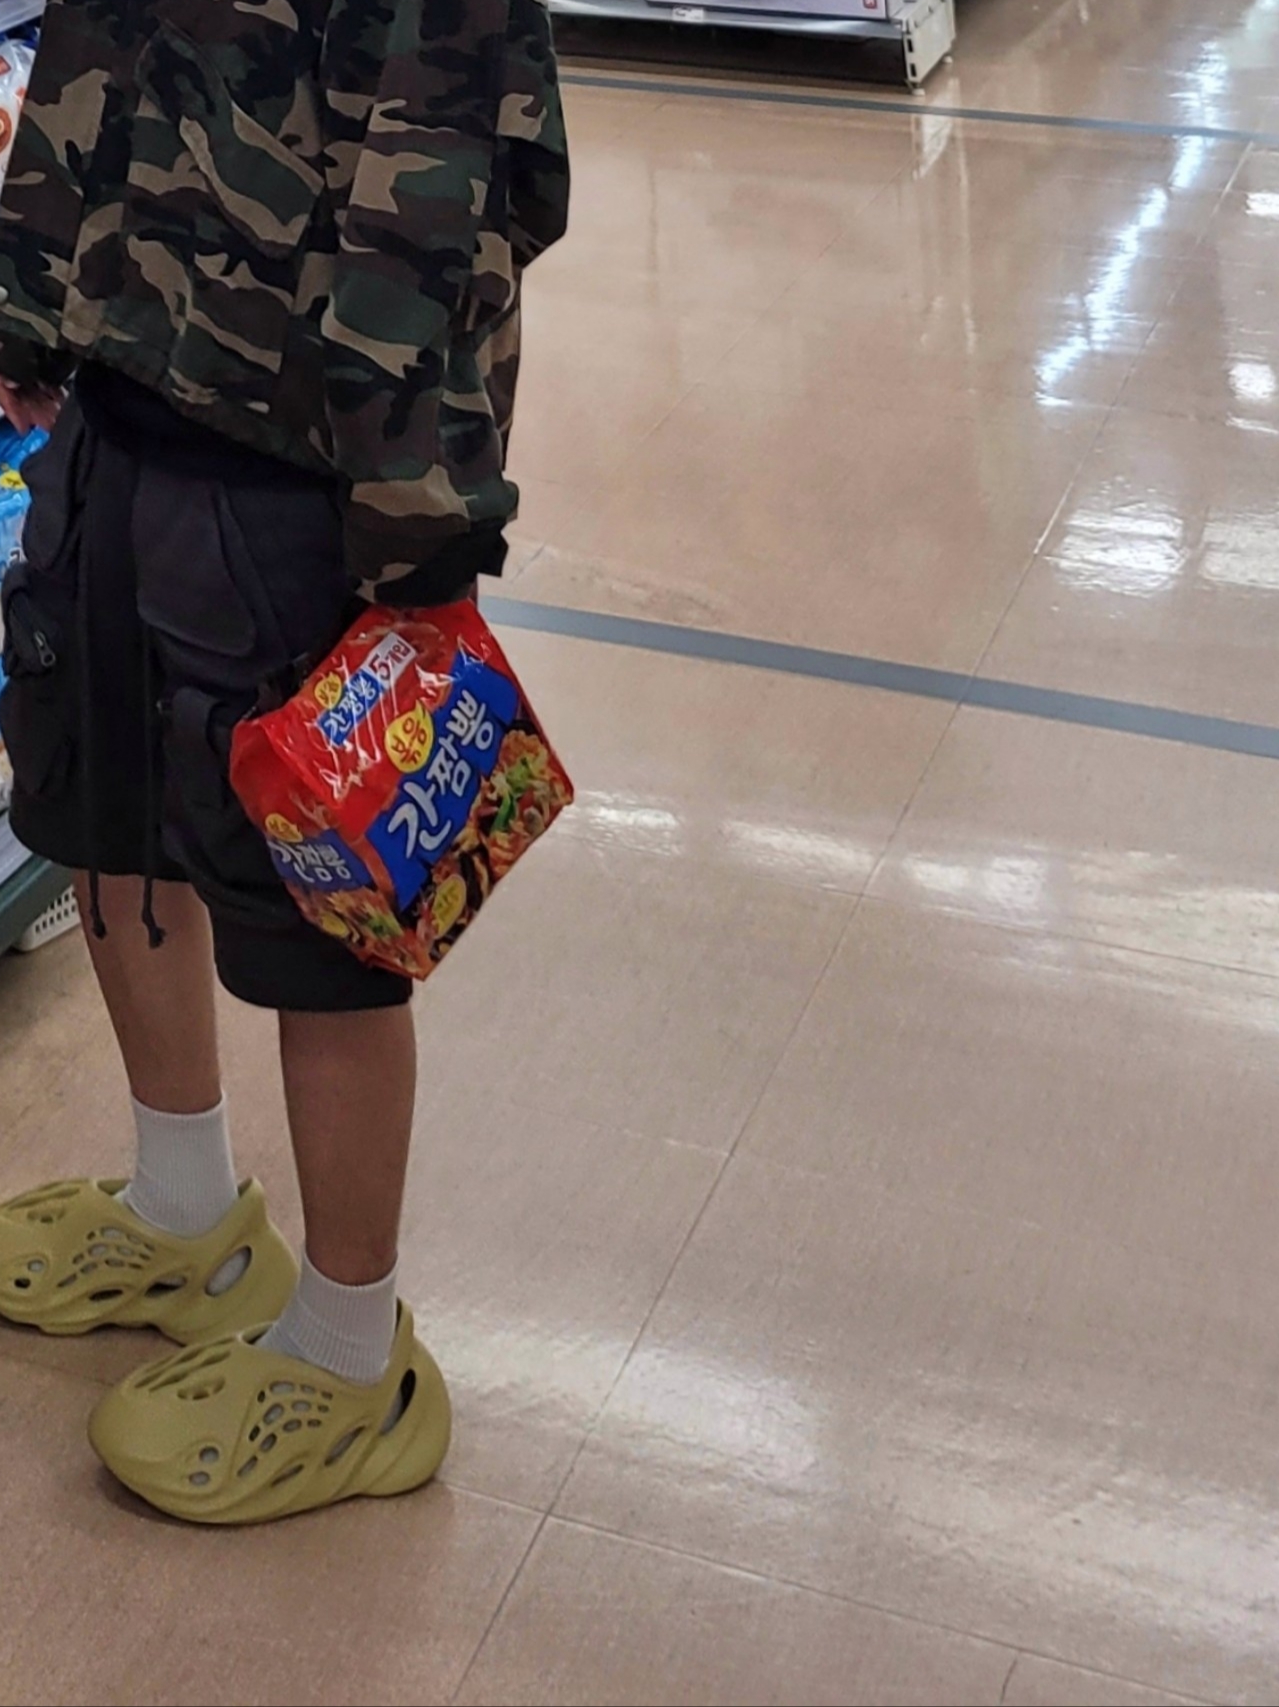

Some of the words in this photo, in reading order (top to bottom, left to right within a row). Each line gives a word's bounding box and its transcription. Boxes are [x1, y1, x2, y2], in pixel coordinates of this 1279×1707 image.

[324, 675, 377, 741] 간짬뽕
[368, 639, 412, 682] 5개입
[387, 688, 496, 861] 간짬뽕
